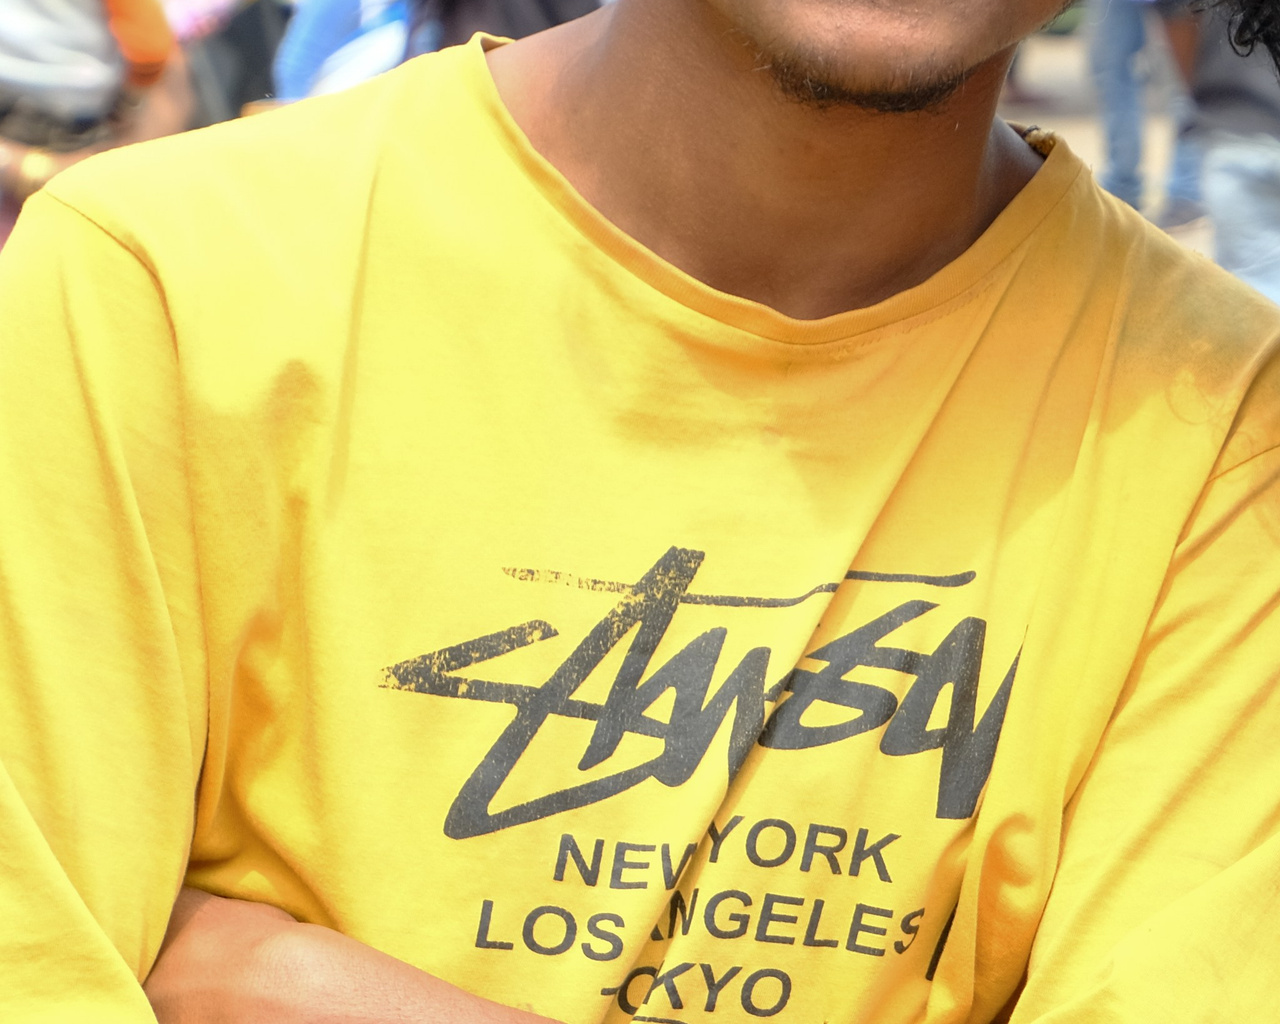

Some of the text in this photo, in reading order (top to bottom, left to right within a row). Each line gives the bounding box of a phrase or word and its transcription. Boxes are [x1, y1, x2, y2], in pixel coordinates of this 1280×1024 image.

[706, 815, 902, 883] YORK
[475, 887, 925, 961] LOS NGELES
[600, 959, 792, 1018] OKYO
